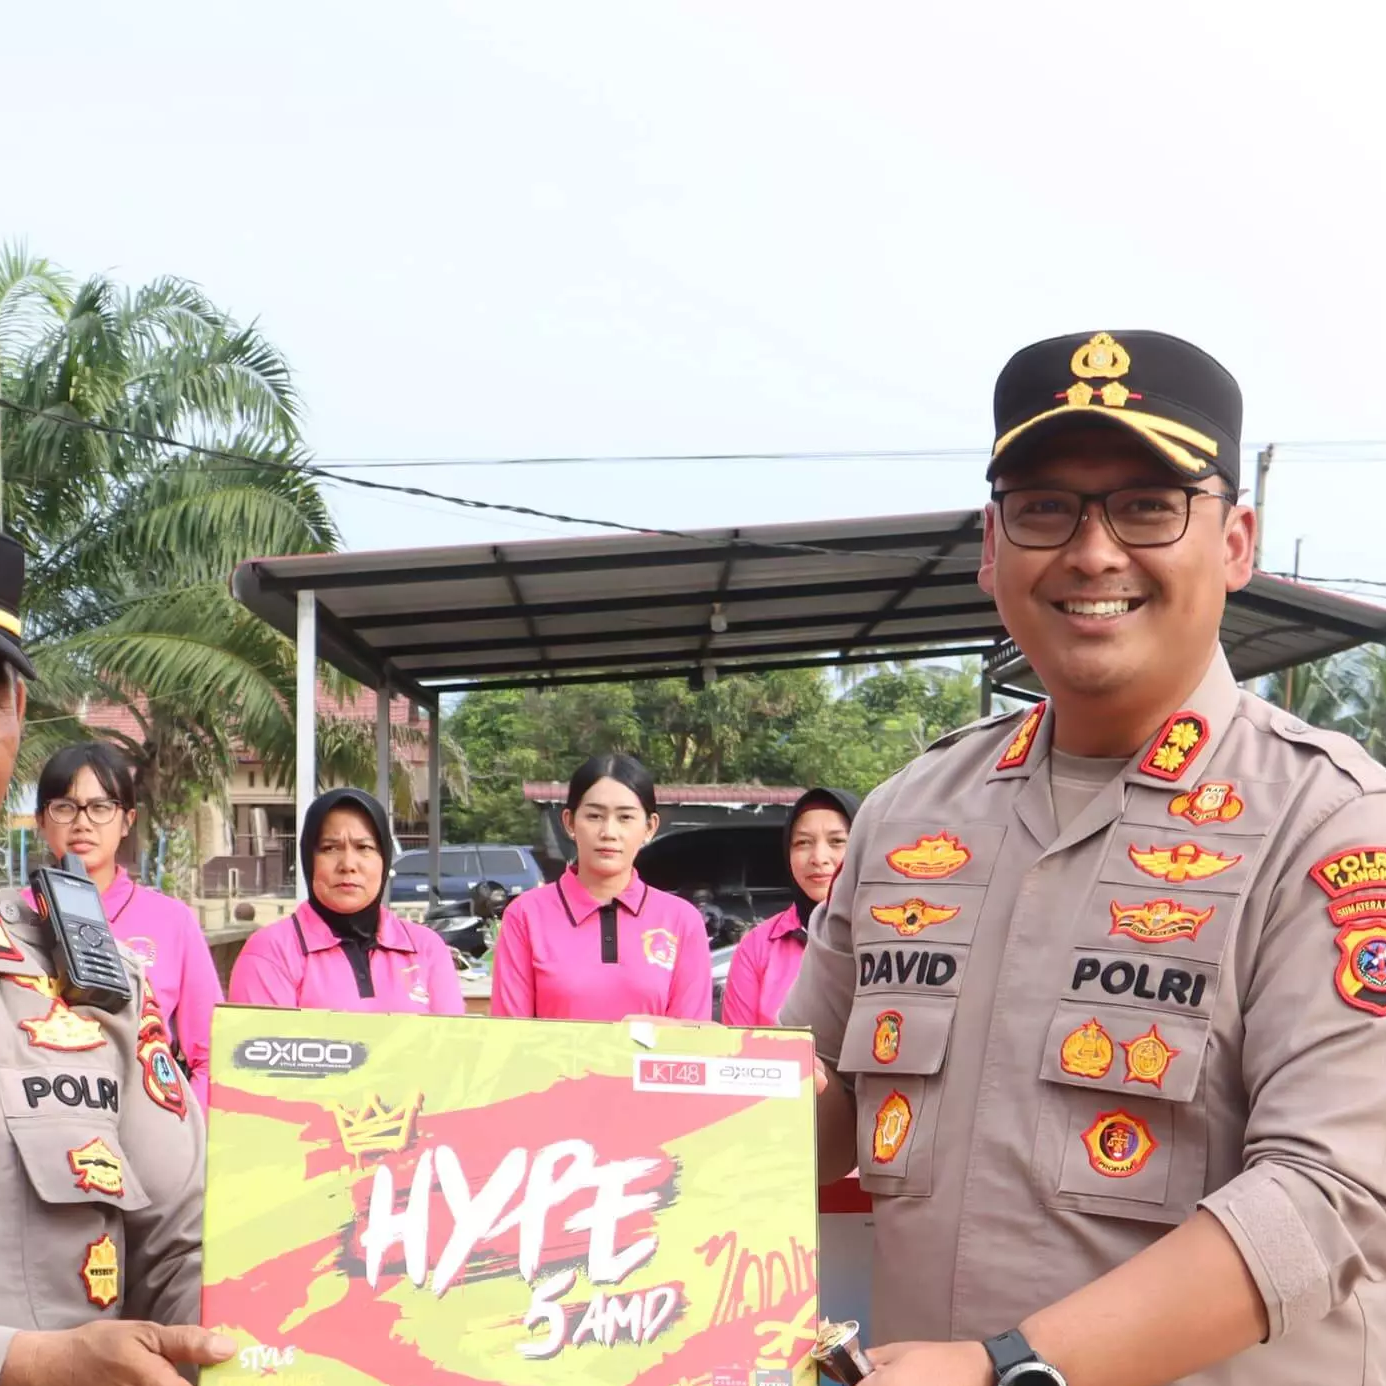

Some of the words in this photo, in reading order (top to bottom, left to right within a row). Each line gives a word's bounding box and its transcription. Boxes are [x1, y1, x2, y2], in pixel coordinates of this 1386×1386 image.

[859, 950, 958, 987] DAVID
[1070, 956, 1208, 1007] POLRI
[21, 1073, 120, 1114] POLRI
[644, 1062, 700, 1084] JKT48
[359, 1138, 662, 1301] HYPE
[514, 1268, 577, 1360] 5
[572, 1286, 677, 1348] AMD
[239, 1344, 297, 1373] STYLE
